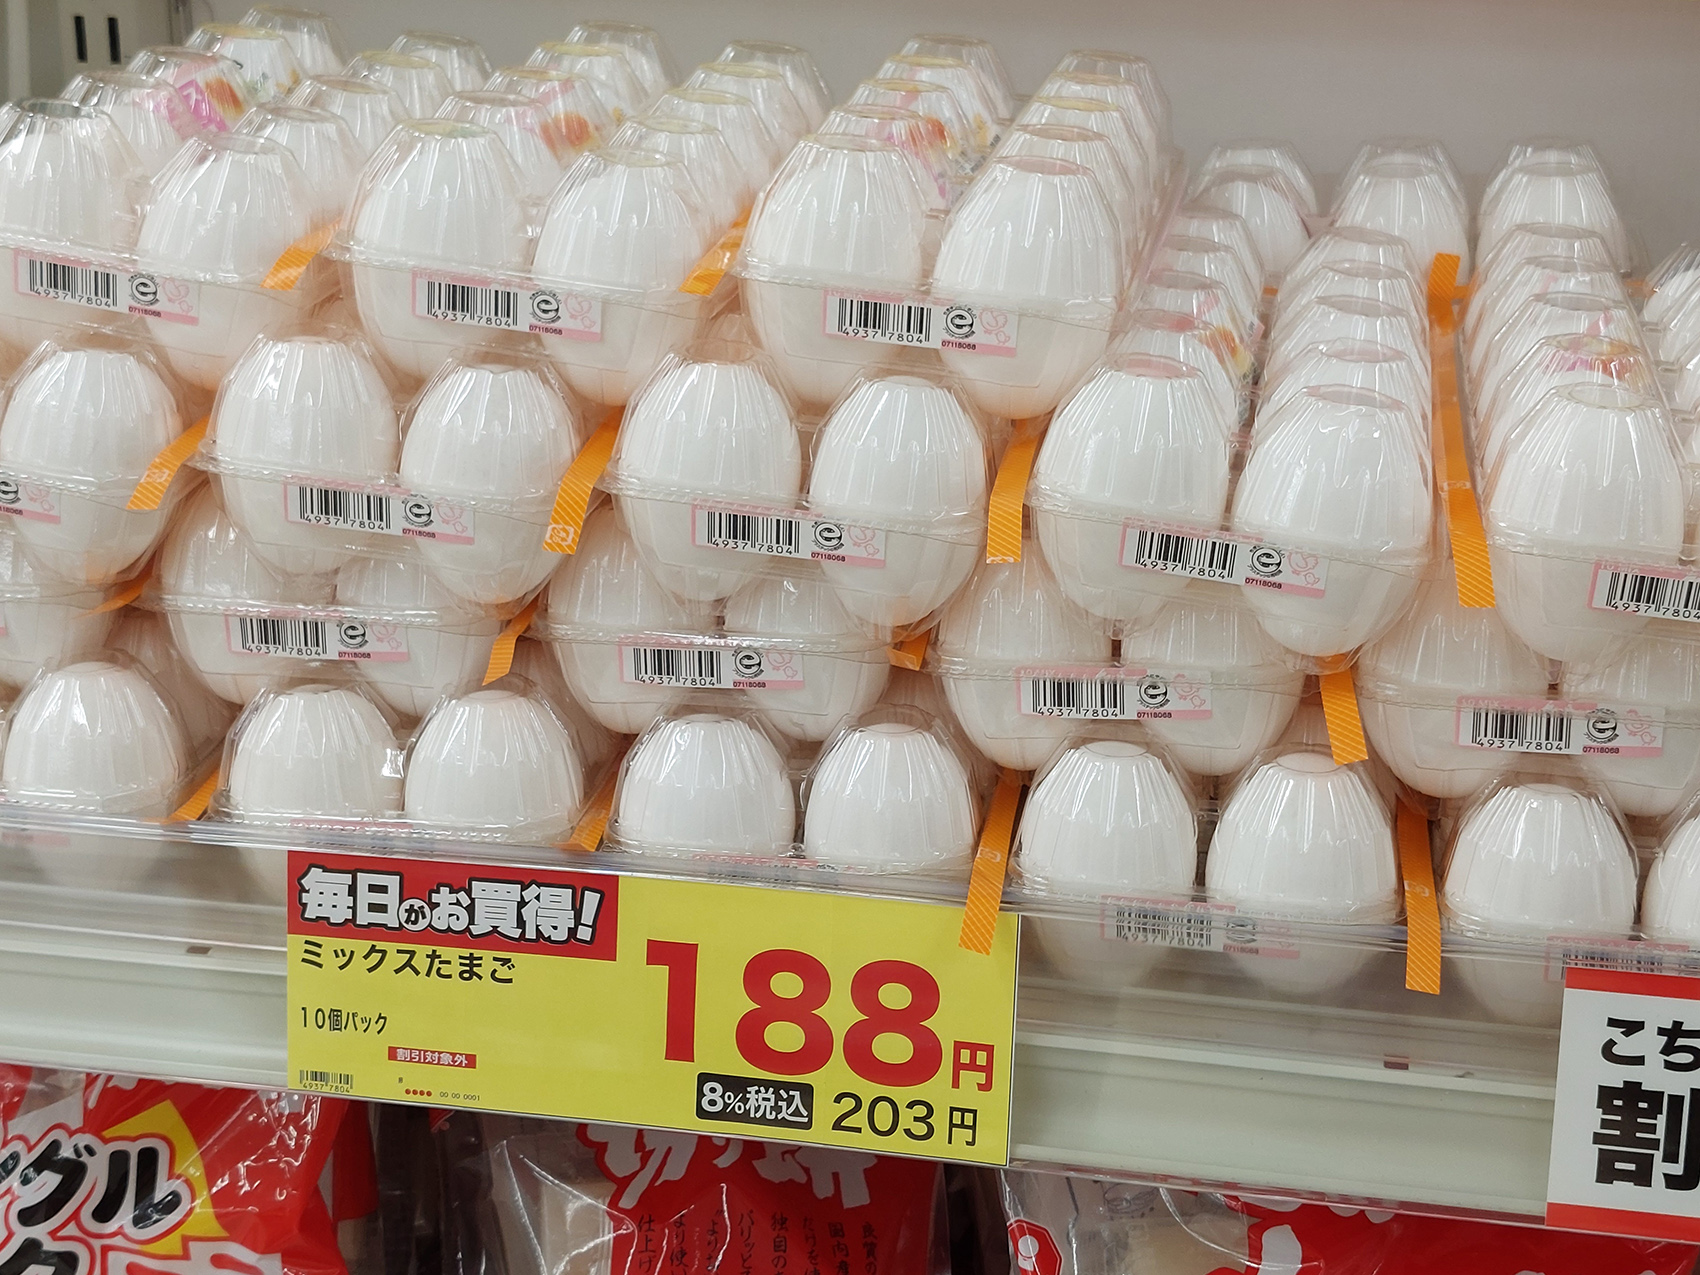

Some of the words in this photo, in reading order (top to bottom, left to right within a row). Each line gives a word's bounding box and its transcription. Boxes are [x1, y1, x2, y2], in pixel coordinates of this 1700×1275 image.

[35, 287, 69, 300] 4937
[78, 294, 112, 308] 7804
[432, 310, 467, 322] 4937
[476, 315, 511, 328] 7804
[842, 327, 878, 339] 4937
[888, 332, 923, 344] 7804
[305, 514, 340, 525] 4937
[350, 519, 385, 530] 7804
[712, 538, 748, 550] 4937
[757, 543, 792, 555] 7804
[1140, 559, 1178, 572] 4937
[1188, 565, 1225, 579] 7804
[1611, 600, 1651, 614] 4937
[246, 644, 279, 654] 4937
[288, 646, 321, 656] 7804
[640, 674, 673, 684] 4937
[682, 677, 715, 687] 7804
[1037, 706, 1072, 717] 4937
[1082, 708, 1118, 718] 7804
[1476, 738, 1515, 749] 4937
[1525, 740, 1562, 752] 7804
[298, 864, 606, 943] 毎日がお買得!
[301, 938, 516, 984] ミックスたまご
[301, 1006, 388, 1035] 10個パック
[1600, 1016, 1700, 1073] こち
[396, 1048, 469, 1067] 割引対象外
[303, 1082, 324, 1091] 4937
[329, 1084, 351, 1094] 7804
[700, 1081, 809, 1123] 8%税込
[1592, 1080, 1700, 1190] 割
